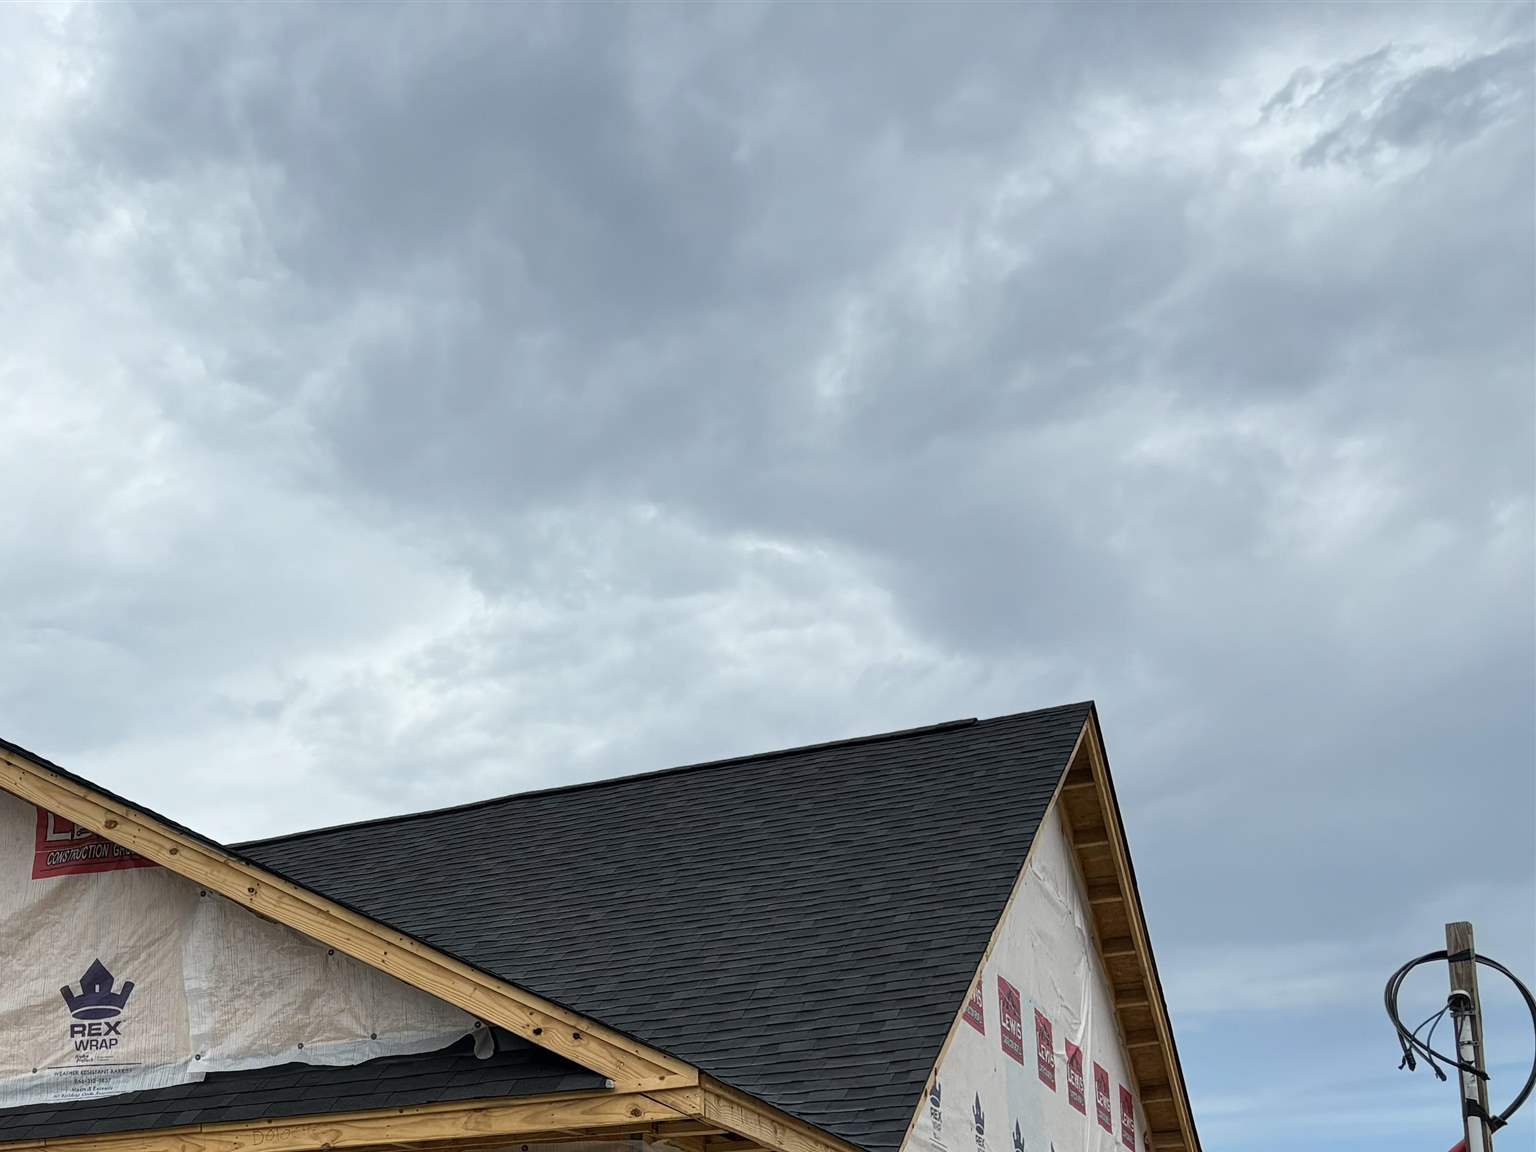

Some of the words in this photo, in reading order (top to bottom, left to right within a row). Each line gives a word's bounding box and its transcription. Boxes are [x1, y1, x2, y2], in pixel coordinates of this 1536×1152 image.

[47, 844, 110, 866] CONSTRUCTION
[70, 1021, 122, 1039] REX
[74, 1038, 119, 1051] WRAP
